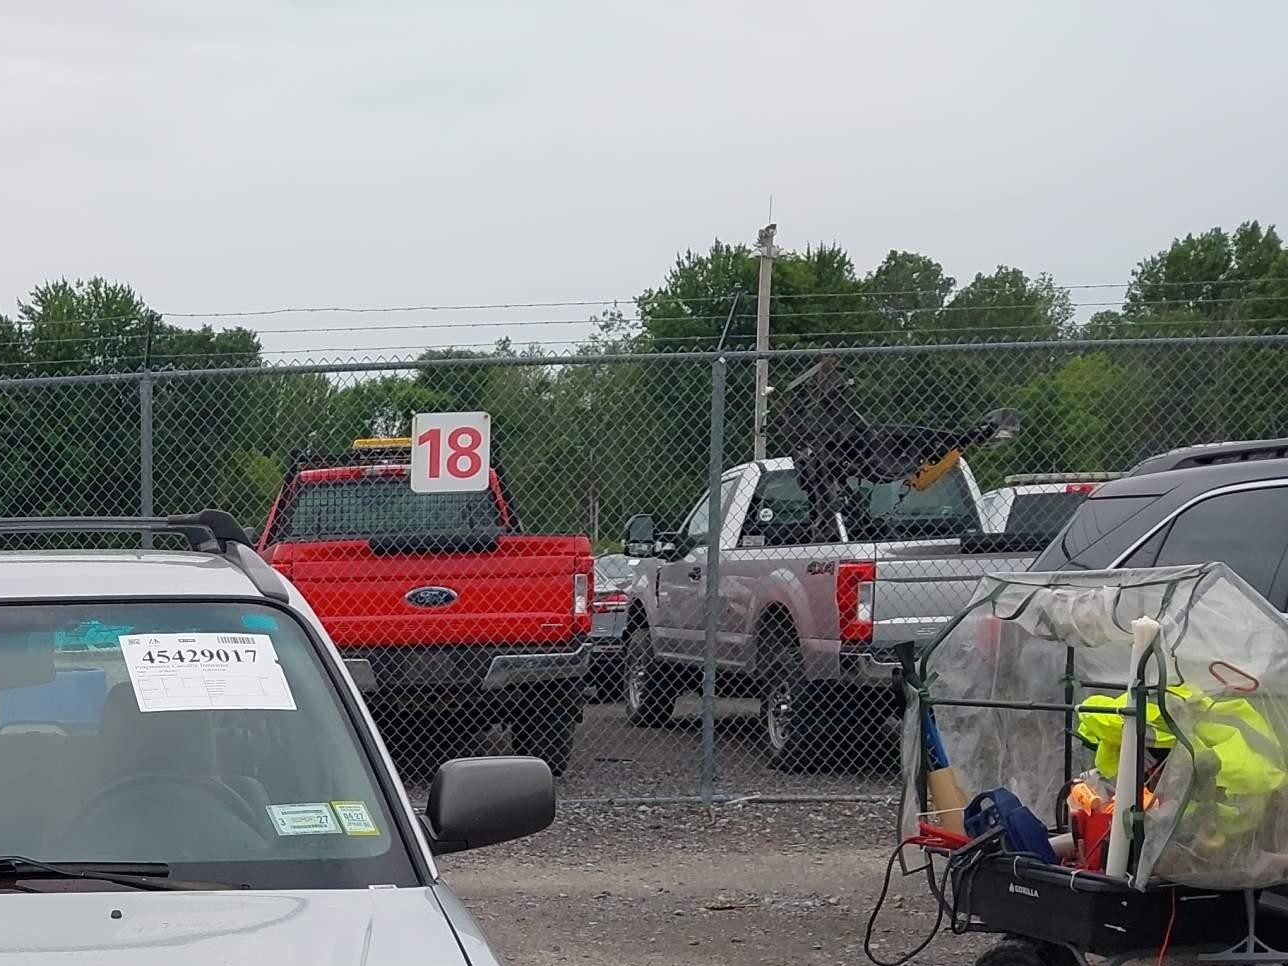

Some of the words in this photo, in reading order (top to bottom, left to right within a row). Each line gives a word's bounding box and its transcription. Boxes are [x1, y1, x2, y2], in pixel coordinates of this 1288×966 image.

[418, 427, 482, 479] 18
[142, 649, 257, 664] 45429017
[278, 817, 287, 826] 3
[317, 815, 329, 824] 27
[1015, 885, 1040, 898] GORILLA
